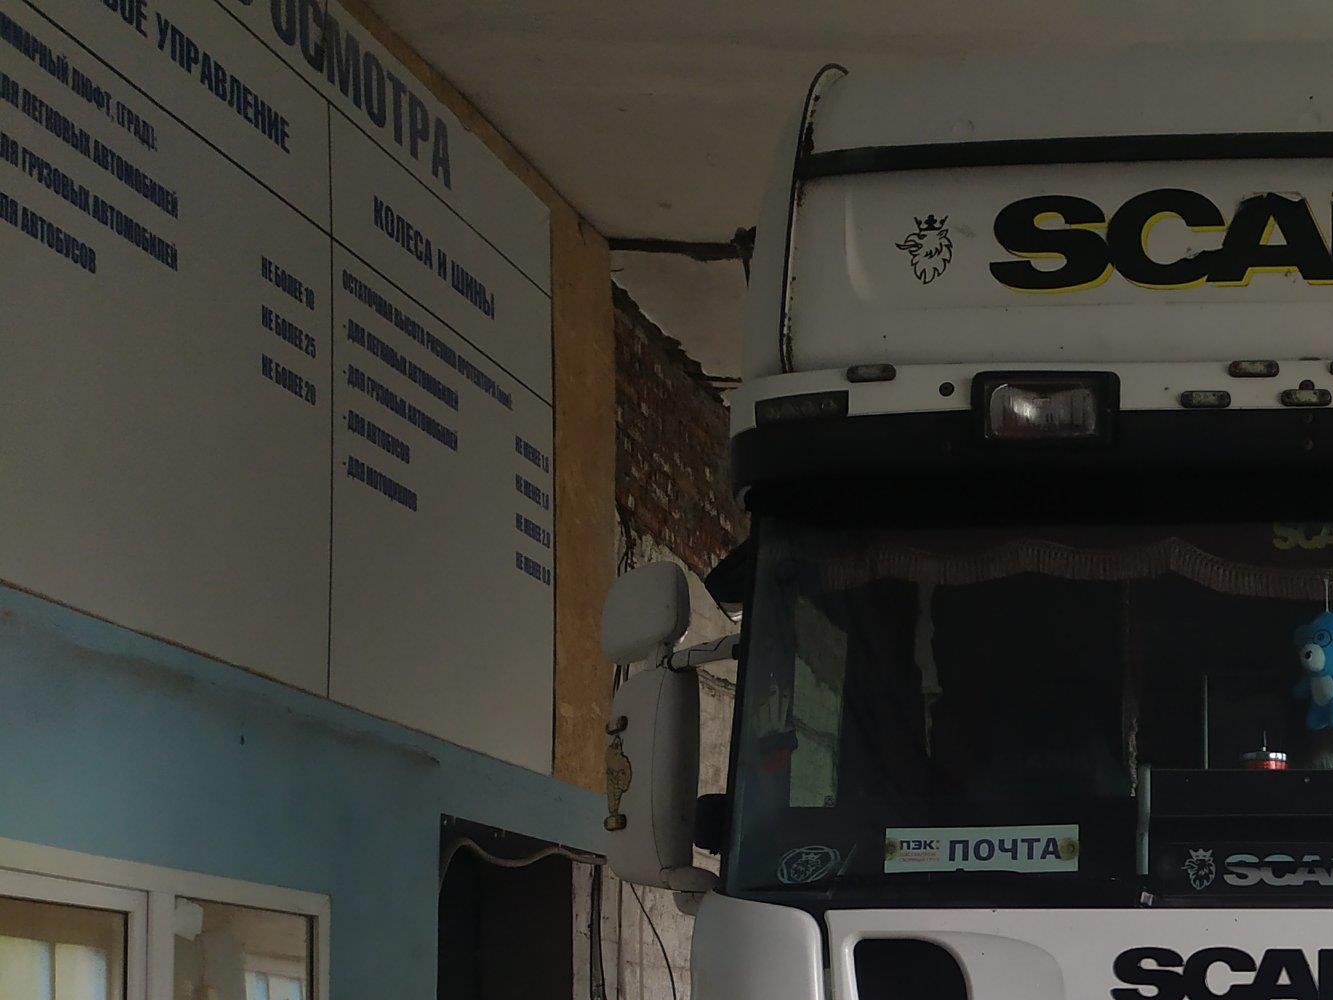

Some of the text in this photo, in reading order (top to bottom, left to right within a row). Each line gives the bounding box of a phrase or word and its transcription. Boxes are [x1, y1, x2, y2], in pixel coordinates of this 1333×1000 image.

[156, 11, 290, 154] УПРАВЛЕНИЕ
[21, 88, 91, 159] ЛЕГКОВЫХ
[93, 138, 178, 219] АВТОМОБИЛЕЙ
[22, 147, 91, 215] ГРУЗОВЫХ
[92, 194, 178, 272] АВТОМОБИЛЕЙ
[21, 206, 96, 274] АВТОБУСОВ
[374, 195, 495, 320] КОЛЕСА И ШИНЫ
[262, 255, 315, 311] НЕ БОЛЕЕ 10
[262, 304, 316, 360] НЕ БОЛЕЕ 25
[347, 318, 365, 348] ДЛЯ
[262, 352, 316, 406] НЕ БОЛЕЕ 20
[347, 363, 365, 392] ДЛЯ
[347, 409, 410, 464] ДЛЯ АВТОБУСОВ
[948, 837, 1062, 862] ПОЧТА
